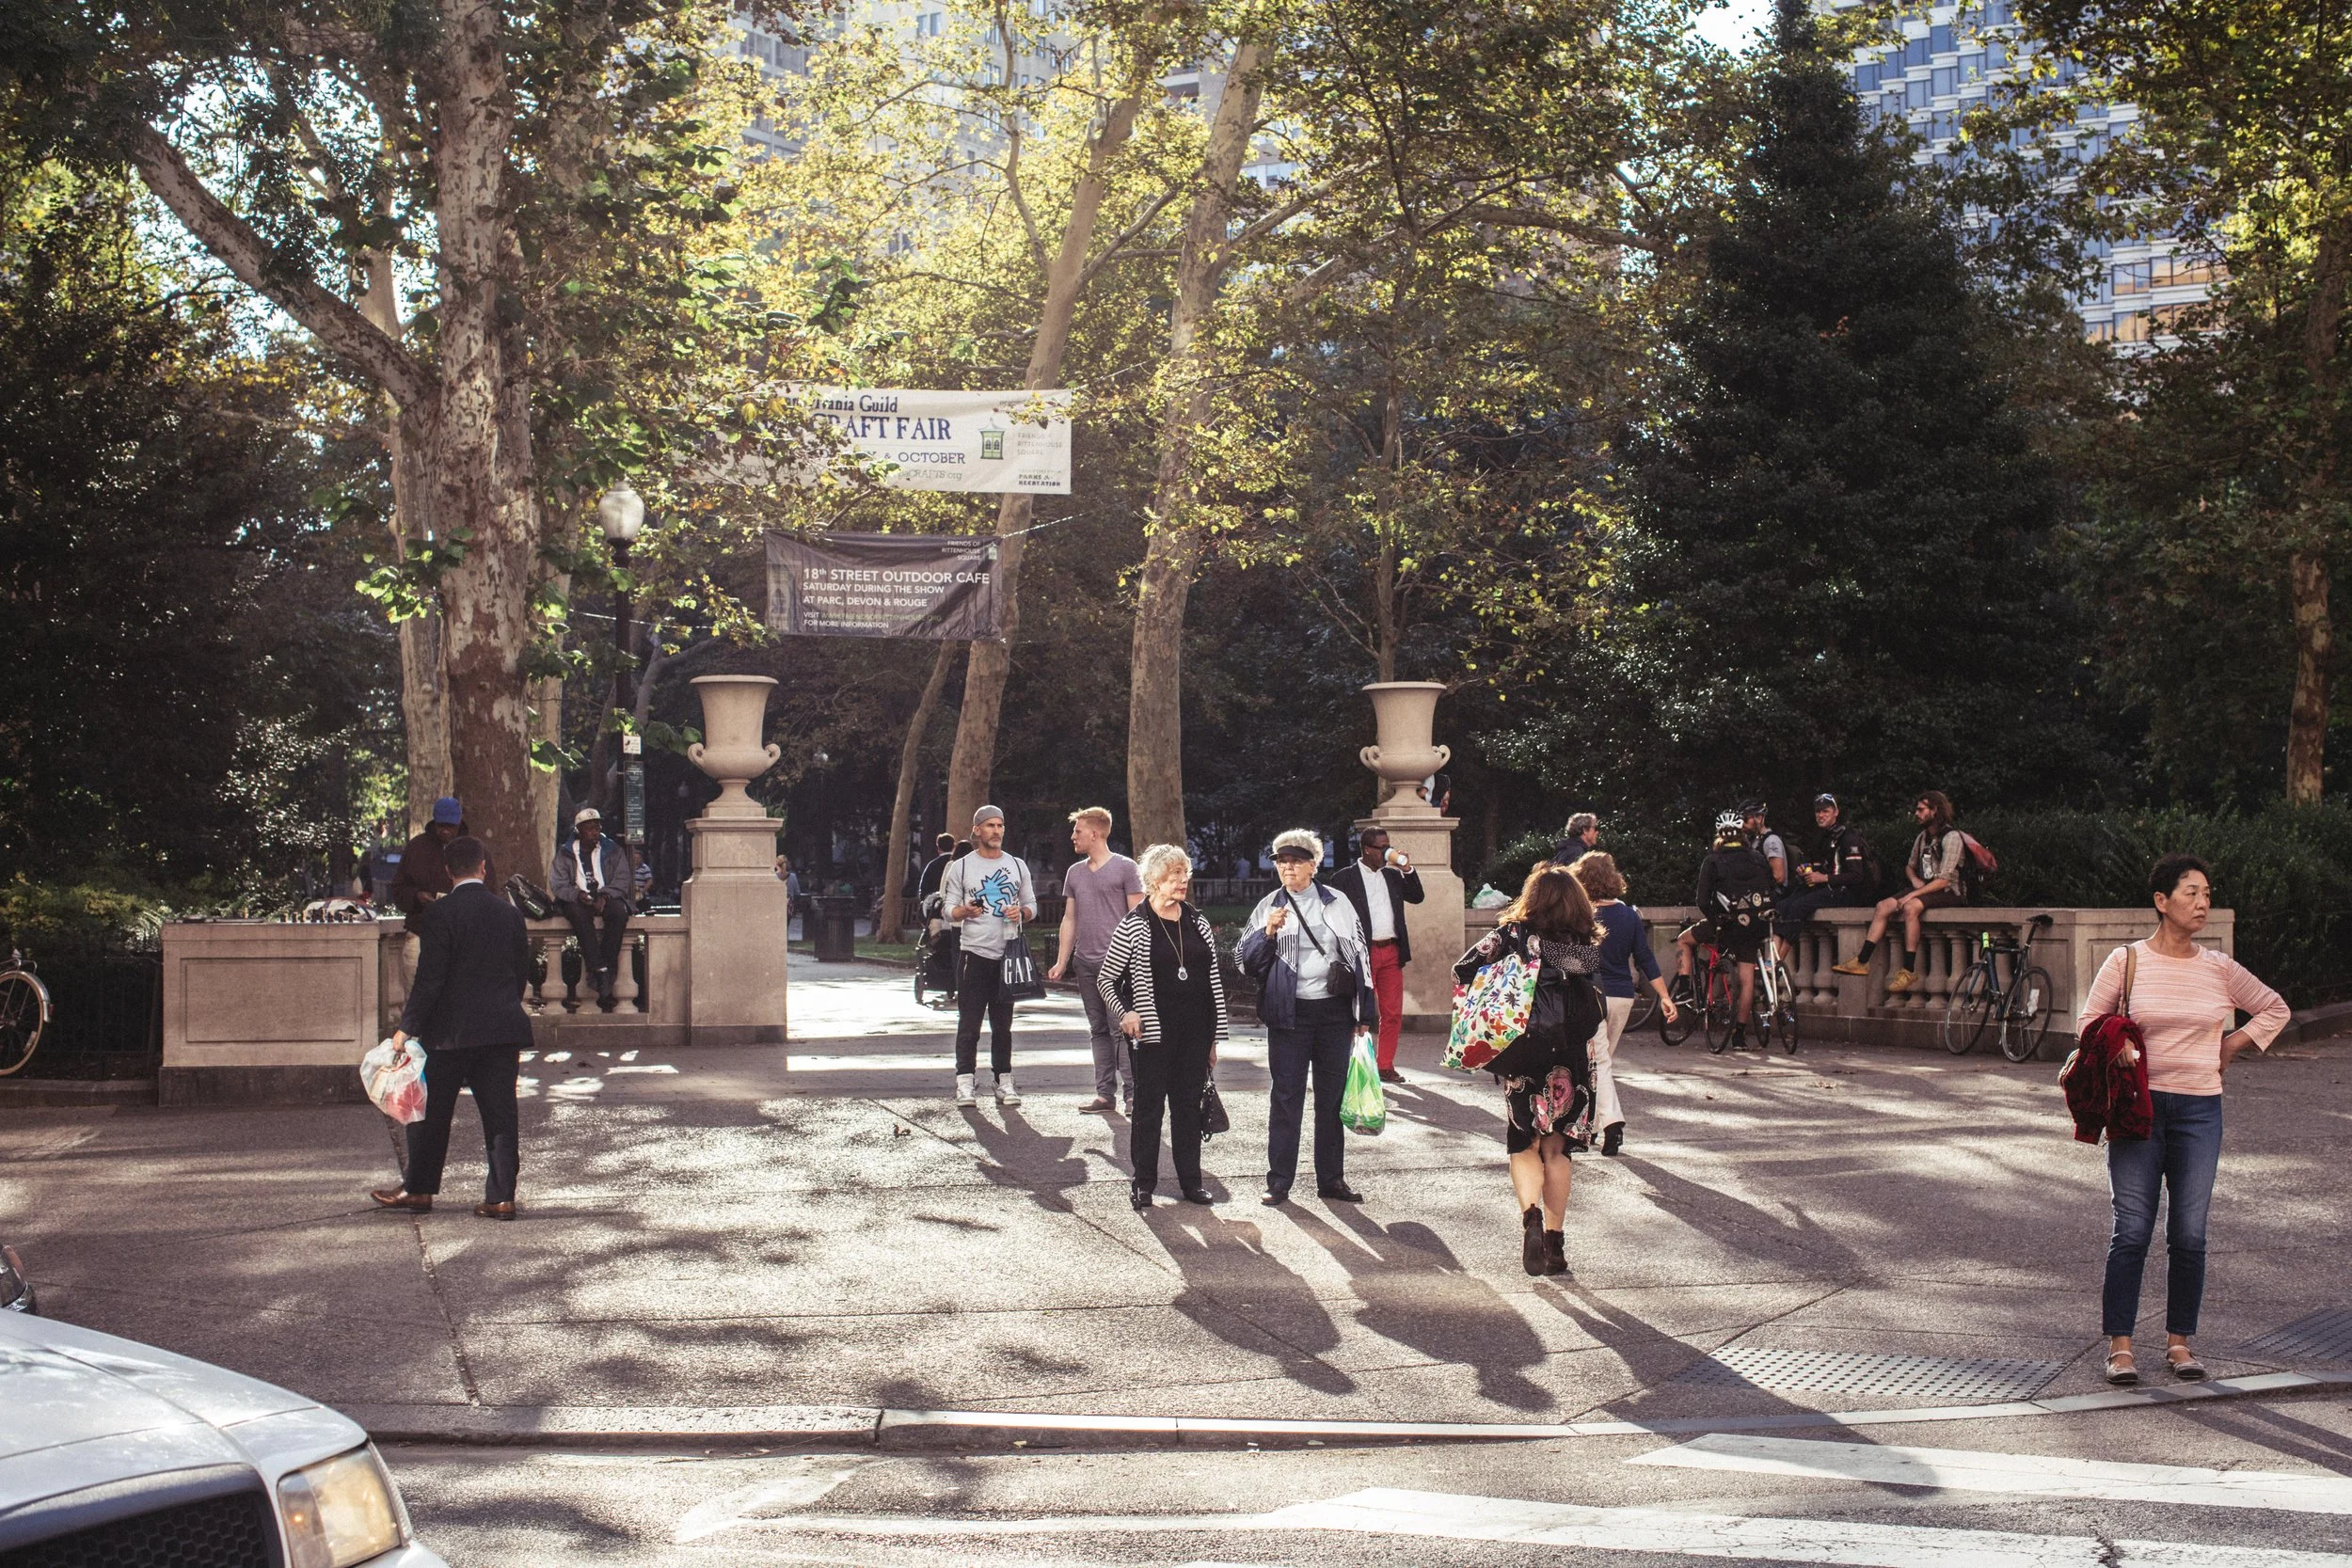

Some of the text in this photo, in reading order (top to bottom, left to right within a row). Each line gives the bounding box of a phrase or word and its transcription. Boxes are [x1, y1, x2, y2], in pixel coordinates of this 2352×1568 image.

[859, 395, 898, 413] Guild
[897, 417, 952, 440] FAIR
[898, 451, 966, 465] OCTOBER
[803, 568, 991, 584] 18th STREET OUTDOOR CAFE
[803, 582, 945, 594] SATURDAY DURING THE SHOW
[803, 595, 928, 607] AT PARC, DEVON & ROUGE
[1004, 957, 1033, 985] GAP
